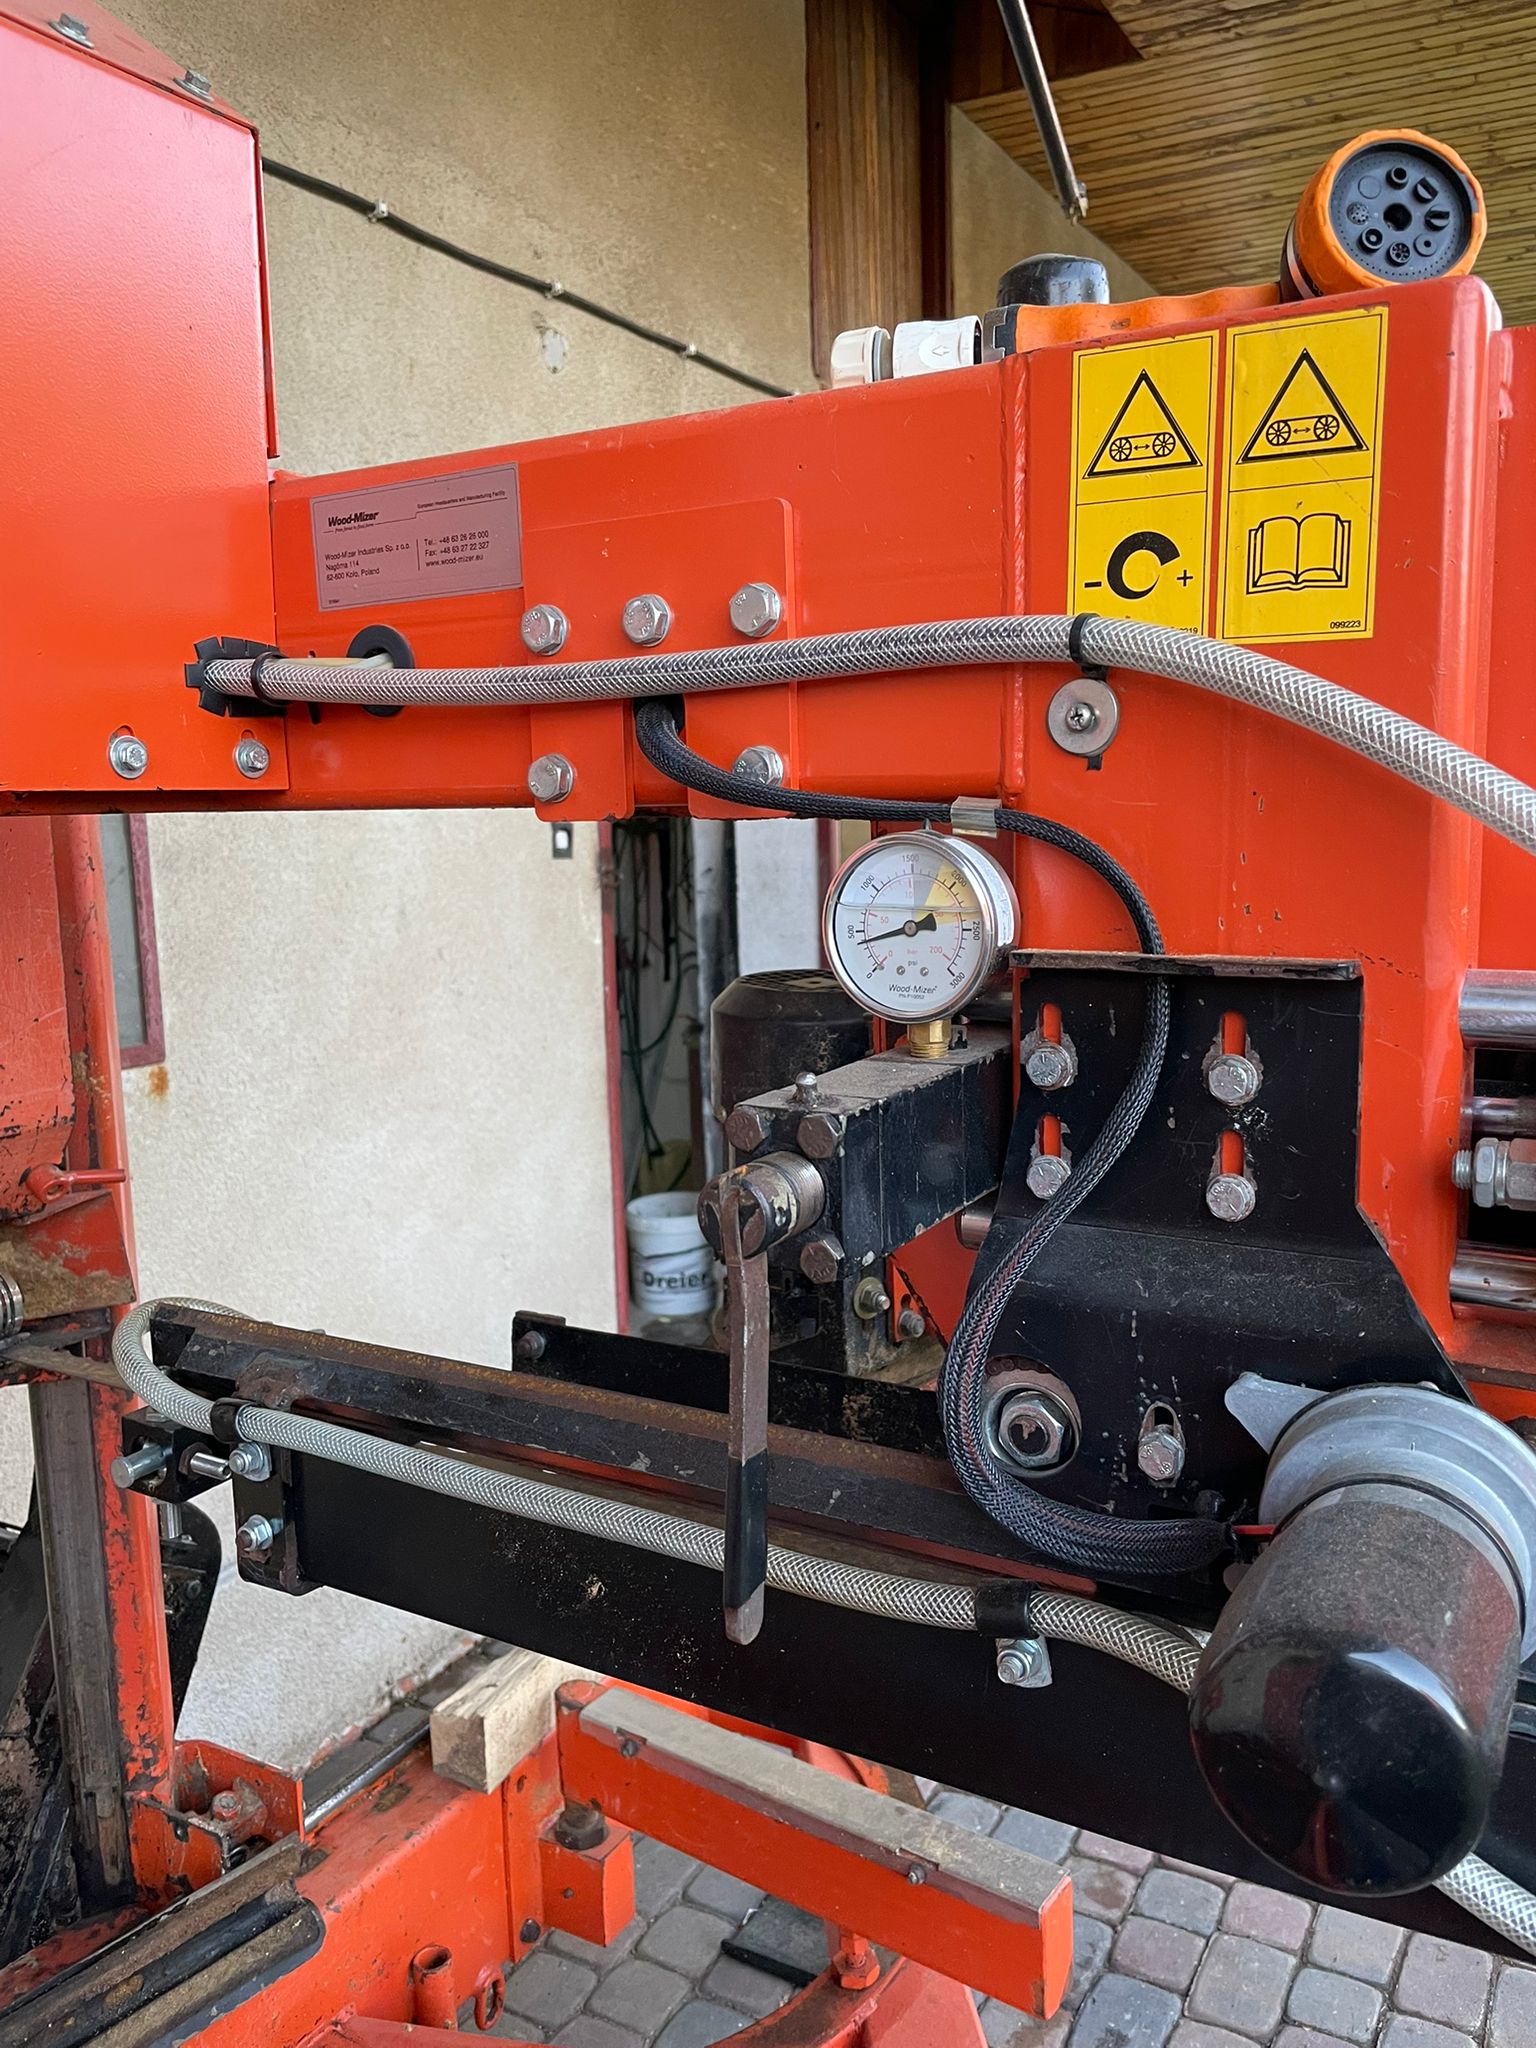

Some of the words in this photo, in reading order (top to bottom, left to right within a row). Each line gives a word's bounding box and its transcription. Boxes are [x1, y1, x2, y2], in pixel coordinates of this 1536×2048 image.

[328, 511, 379, 528] Wood-Mizer
[439, 536, 450, 544] +48
[451, 534, 459, 543] 63
[460, 533, 467, 541] 26
[469, 532, 476, 540] 26
[477, 530, 489, 539] 000
[325, 550, 356, 561] Wood-Mizer
[358, 546, 383, 556] Industries
[440, 547, 450, 555] +48
[451, 545, 460, 554] 63
[461, 544, 468, 552] 27
[469, 542, 477, 551] 22
[478, 541, 489, 550] 327
[349, 560, 359, 568] 114
[326, 572, 345, 581] 62-600
[361, 568, 380, 576] Poland
[1330, 620, 1361, 629] 099223
[902, 853, 919, 863] 1500
[860, 874, 875, 892] 1000
[951, 869, 967, 888] 2000
[880, 916, 889, 924] 50
[847, 924, 855, 939] 500
[972, 920, 980, 941] 2500
[929, 945, 943, 954] 200
[949, 972, 966, 989] 3000
